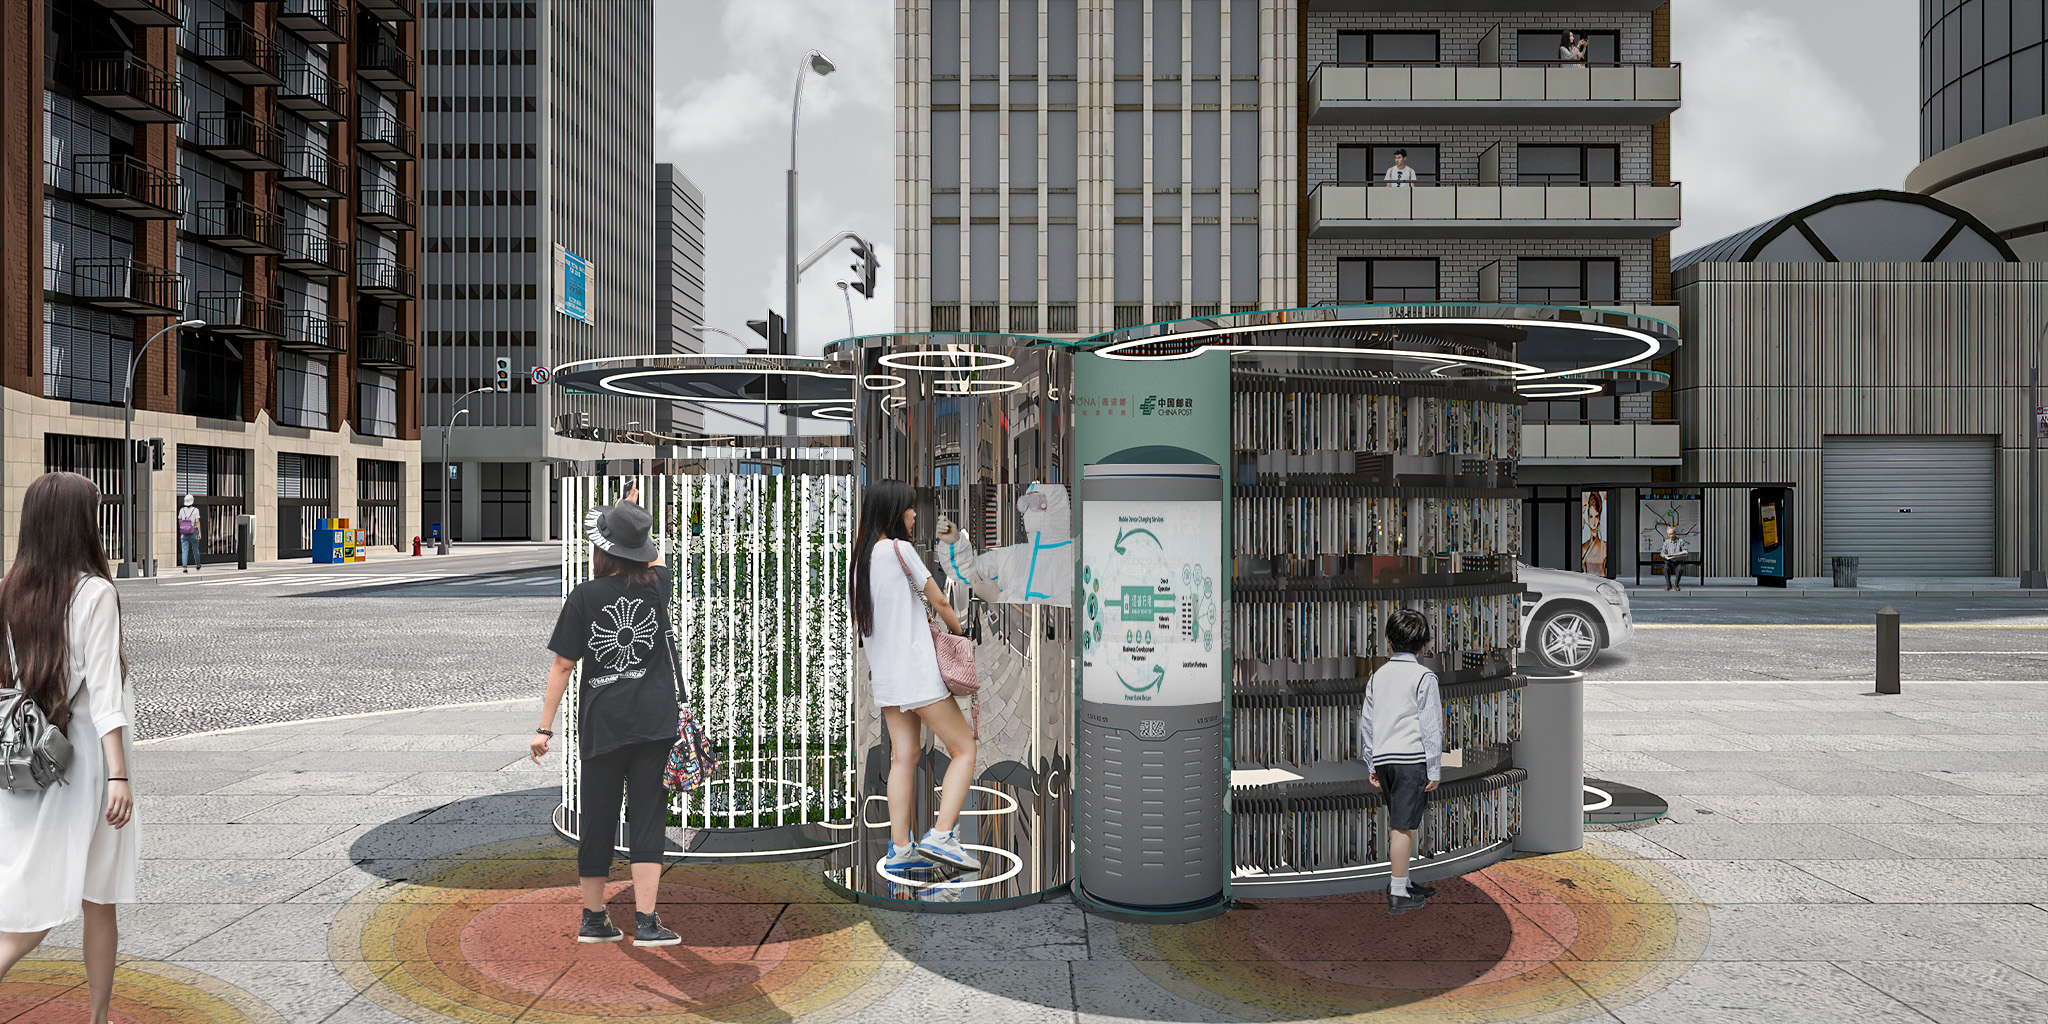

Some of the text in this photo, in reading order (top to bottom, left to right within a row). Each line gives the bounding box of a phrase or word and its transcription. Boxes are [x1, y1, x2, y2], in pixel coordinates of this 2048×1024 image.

[1158, 397, 1193, 408] 中国邮政
[1158, 408, 1193, 416] CHINA POST
